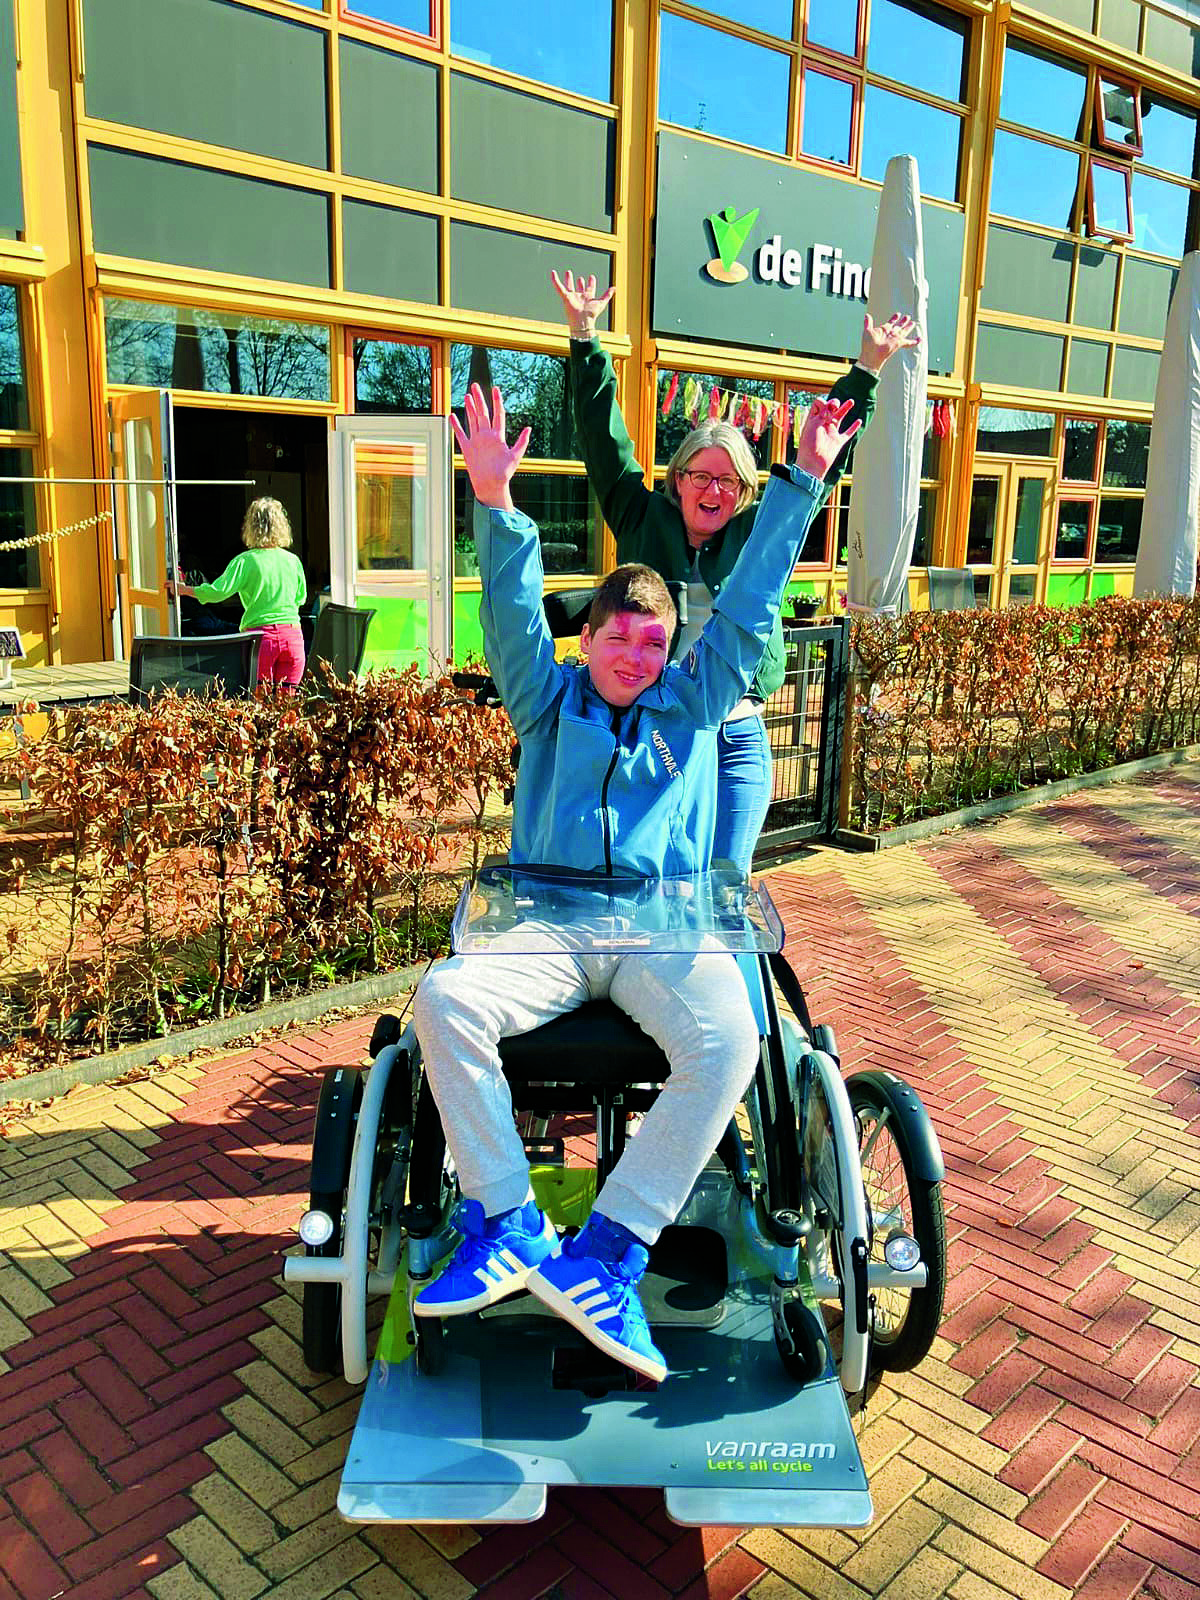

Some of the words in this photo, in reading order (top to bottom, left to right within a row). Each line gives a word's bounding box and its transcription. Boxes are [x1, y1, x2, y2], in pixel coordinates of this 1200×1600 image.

[758, 234, 801, 286] de
[706, 1440, 836, 1459] vanraam
[708, 1459, 744, 1471] Let's
[749, 1460, 768, 1472] all
[772, 1461, 813, 1473] cycle
